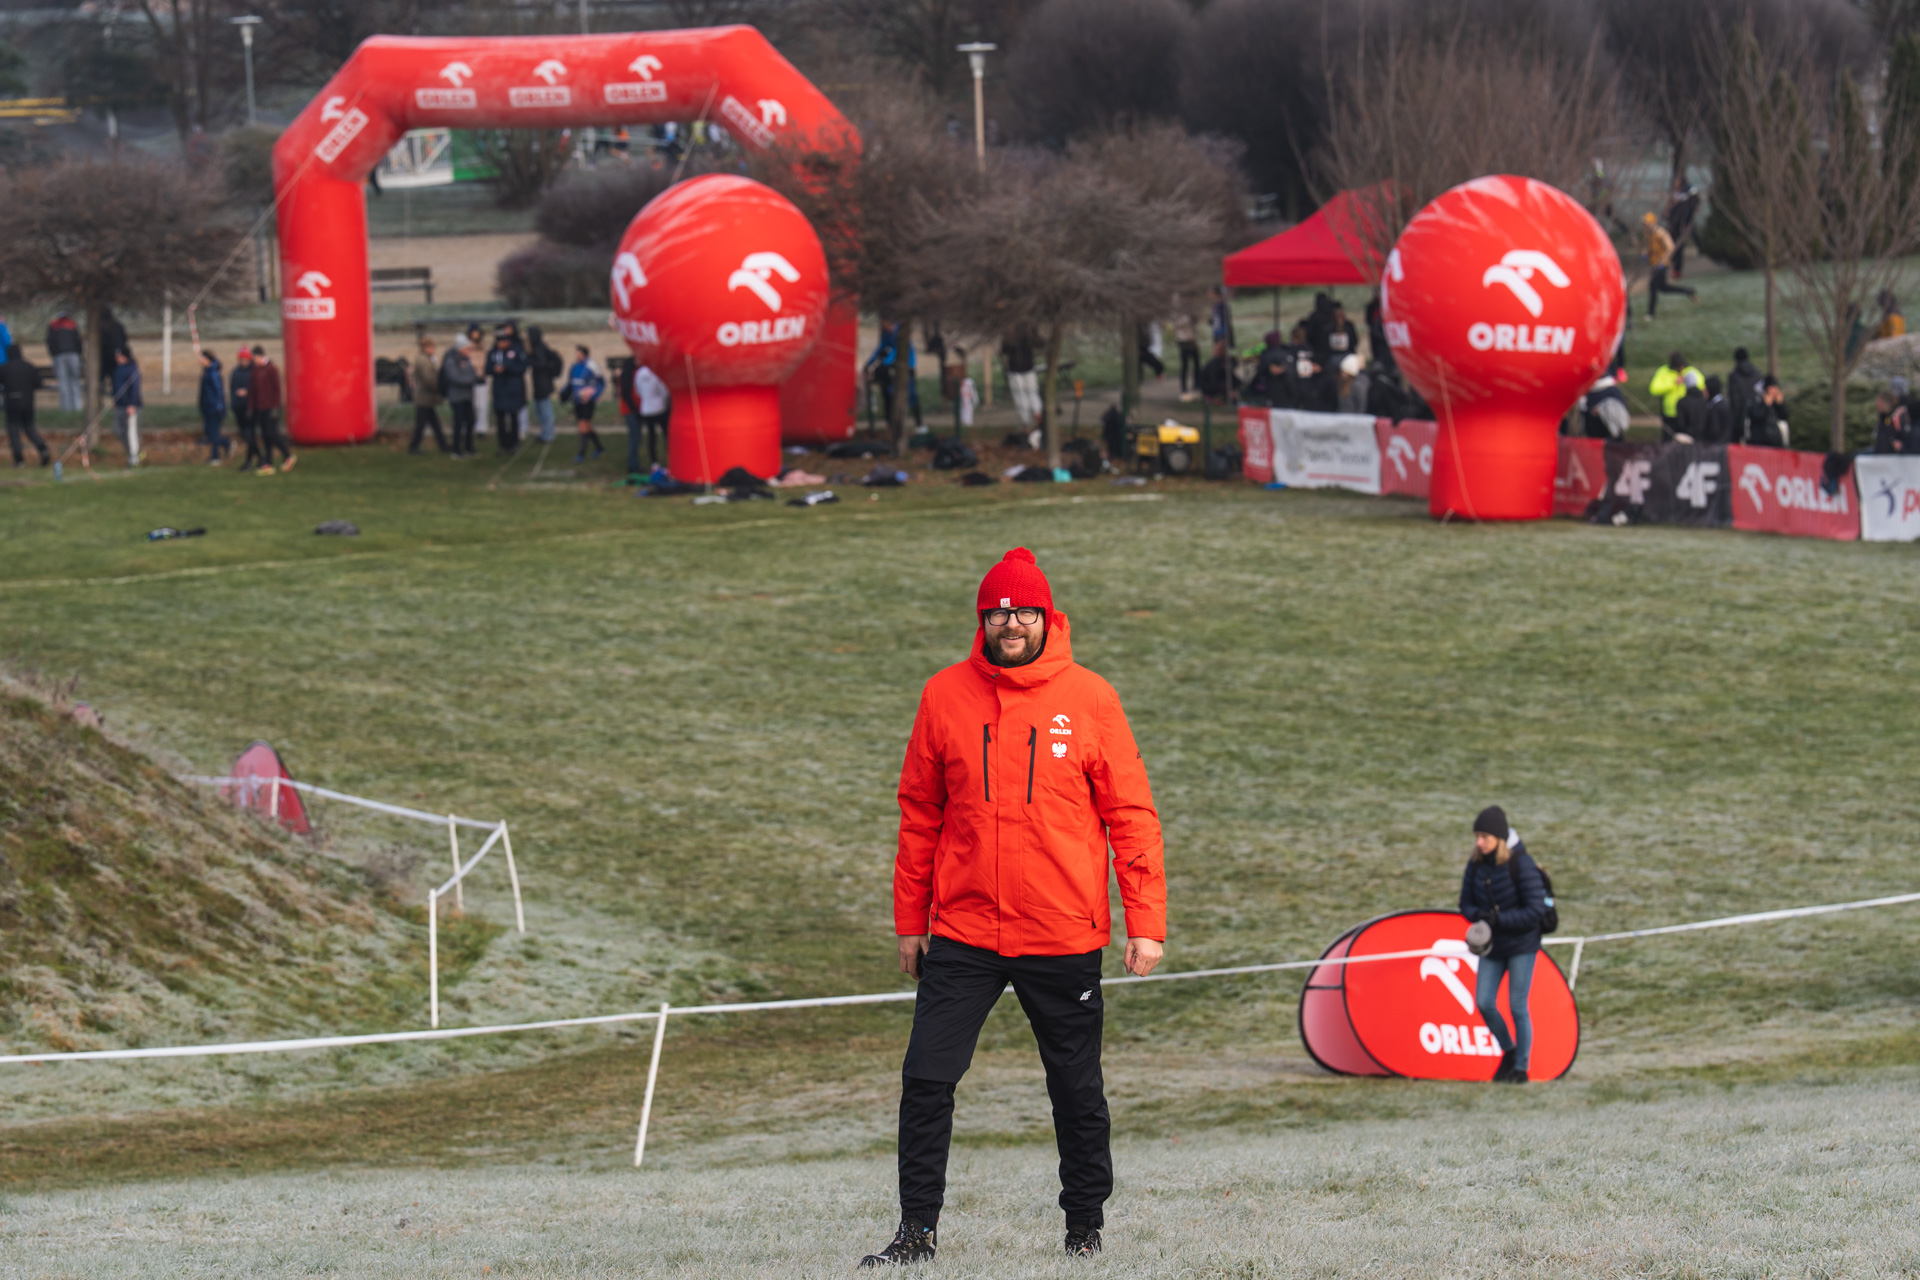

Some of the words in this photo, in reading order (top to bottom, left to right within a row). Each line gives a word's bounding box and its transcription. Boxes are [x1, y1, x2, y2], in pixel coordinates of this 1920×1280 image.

[608, 84, 663, 101] ORLEN
[716, 314, 806, 347] ORLEN
[1467, 321, 1576, 355] ORLEN
[1614, 459, 1652, 505] 4F
[1675, 461, 1721, 508] 4F
[1080, 990, 1092, 1000] 4F
